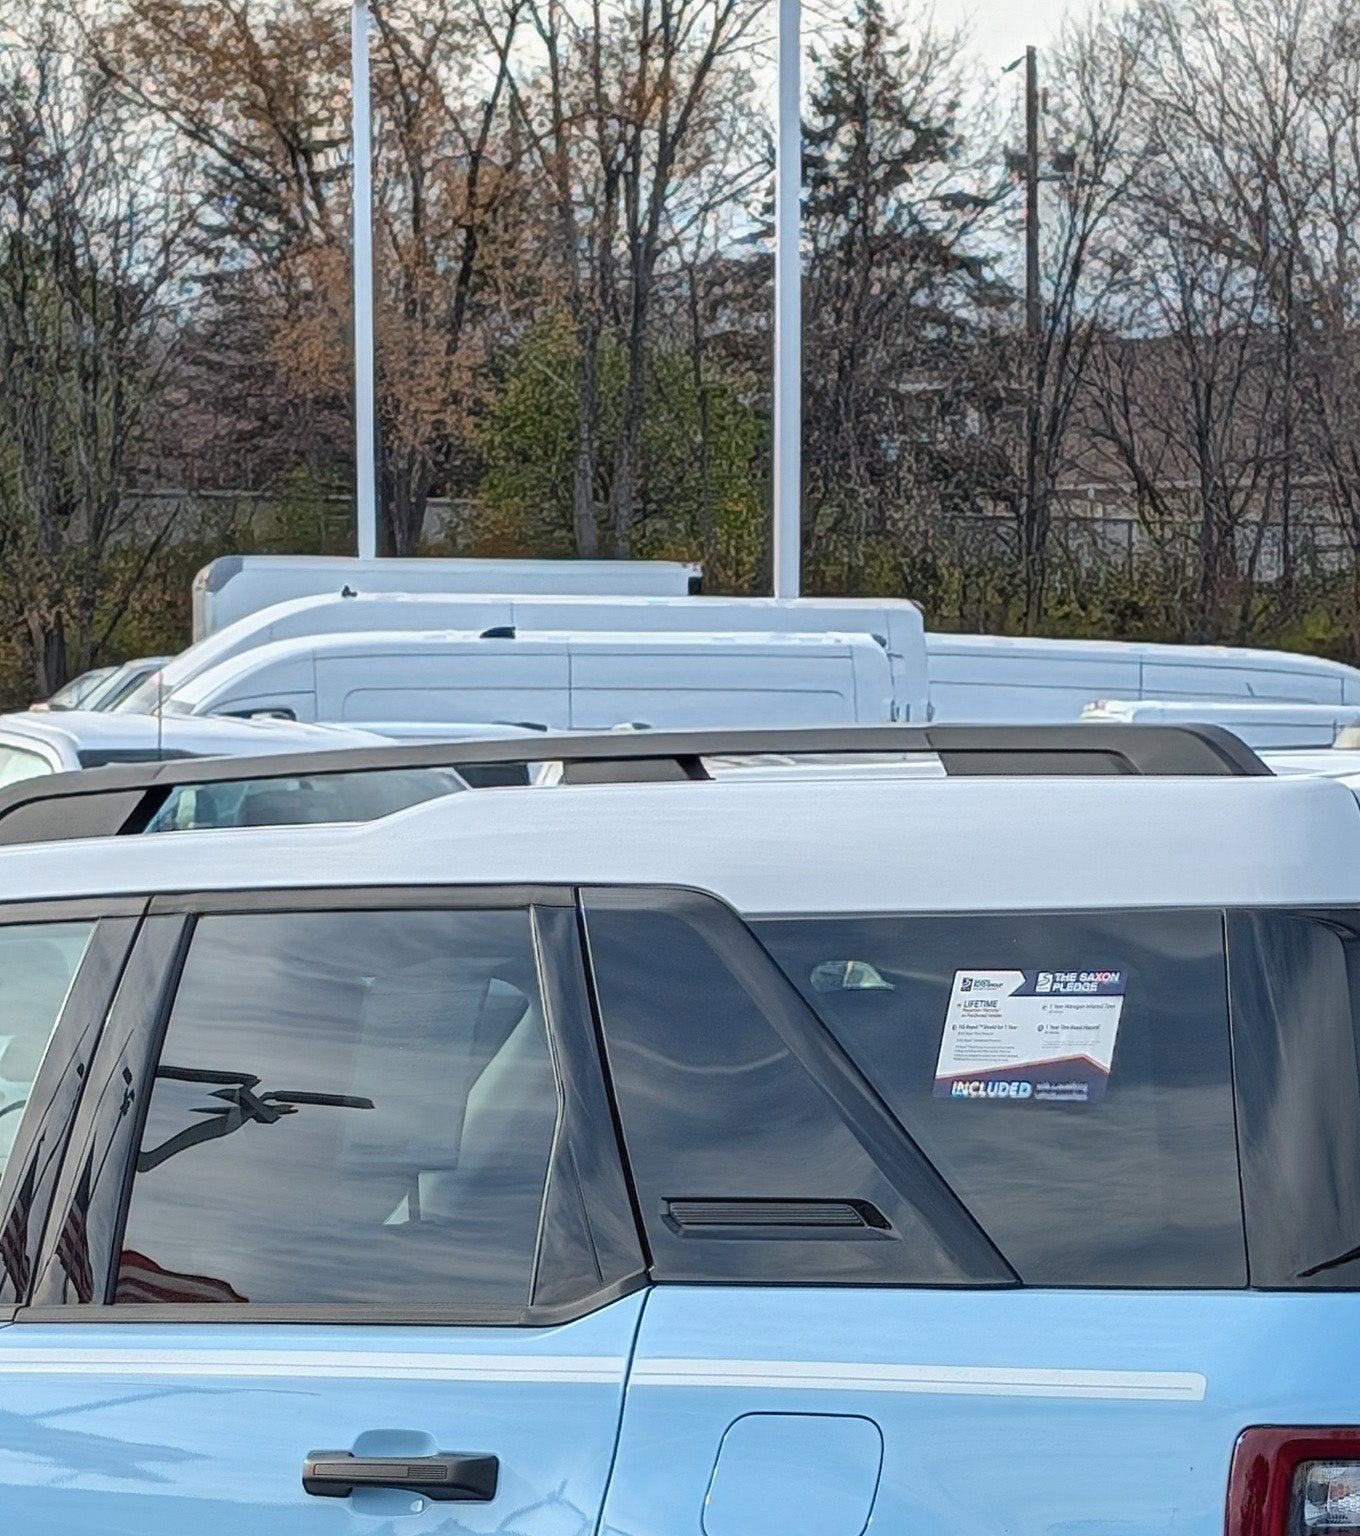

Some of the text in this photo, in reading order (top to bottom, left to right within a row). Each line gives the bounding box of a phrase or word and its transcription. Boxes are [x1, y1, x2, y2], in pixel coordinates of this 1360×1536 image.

[1054, 971, 1120, 982] THE SAXON
[1052, 982, 1098, 992] PLEDGE
[963, 1000, 998, 1008] LIFETIME
[951, 1080, 1032, 1098] INCLUDED
